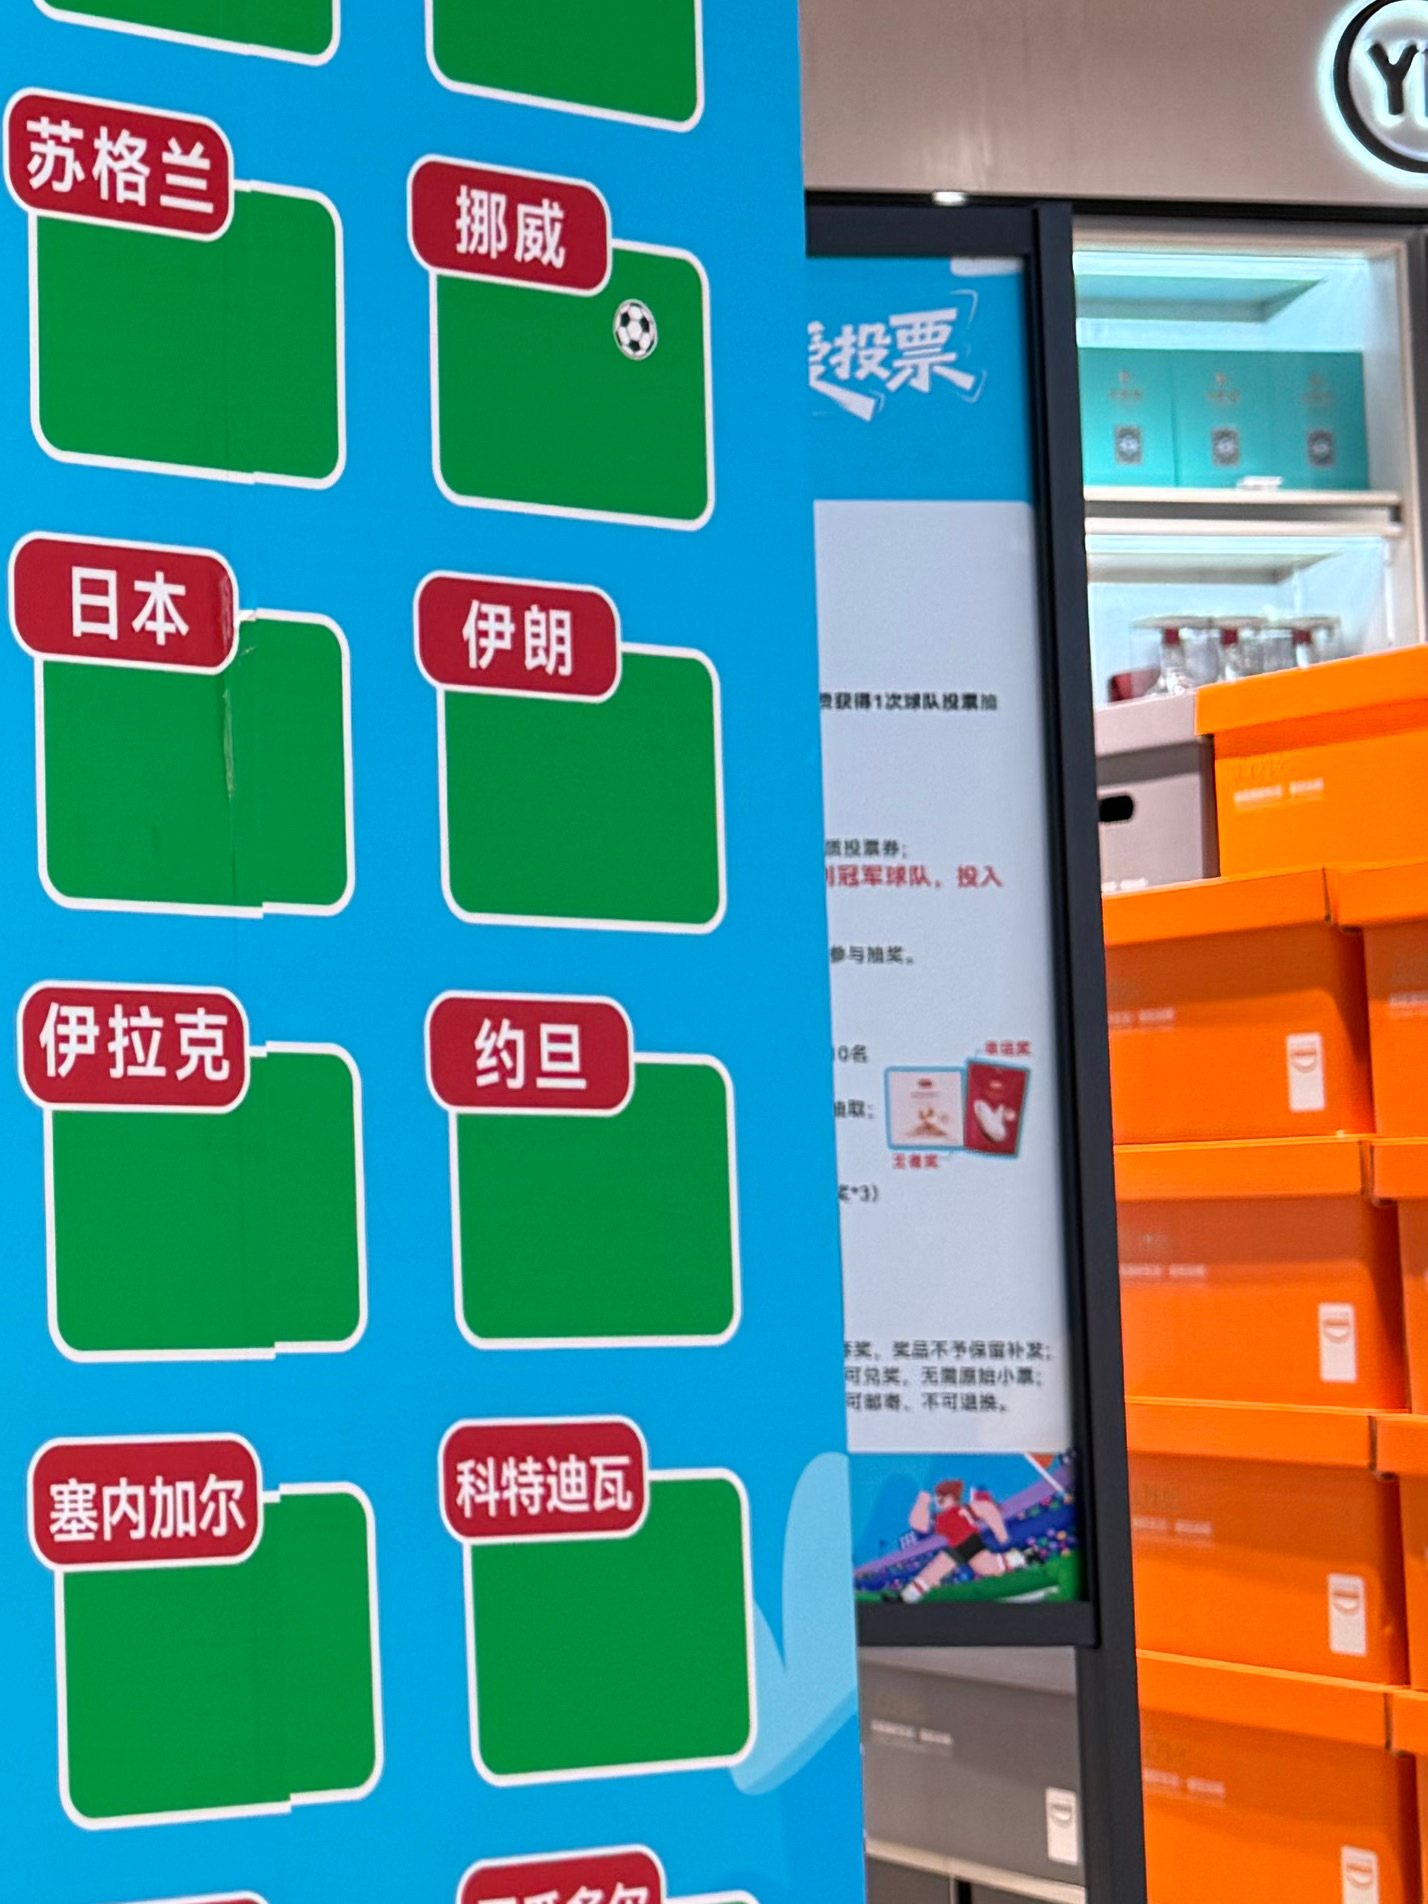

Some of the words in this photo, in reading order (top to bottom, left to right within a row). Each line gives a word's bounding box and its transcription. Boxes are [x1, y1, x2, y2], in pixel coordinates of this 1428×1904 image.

[27, 117, 213, 213] 苏格兰
[456, 185, 565, 268] 挪威
[72, 566, 189, 645] 日本
[462, 600, 572, 675] 伊朗
[40, 1002, 229, 1080] 伊拉克
[475, 1019, 586, 1089] 约旦
[832, 1045, 868, 1063] 0名
[50, 1474, 245, 1541] 塞内加尔
[456, 1454, 632, 1517] 科特迪瓦
